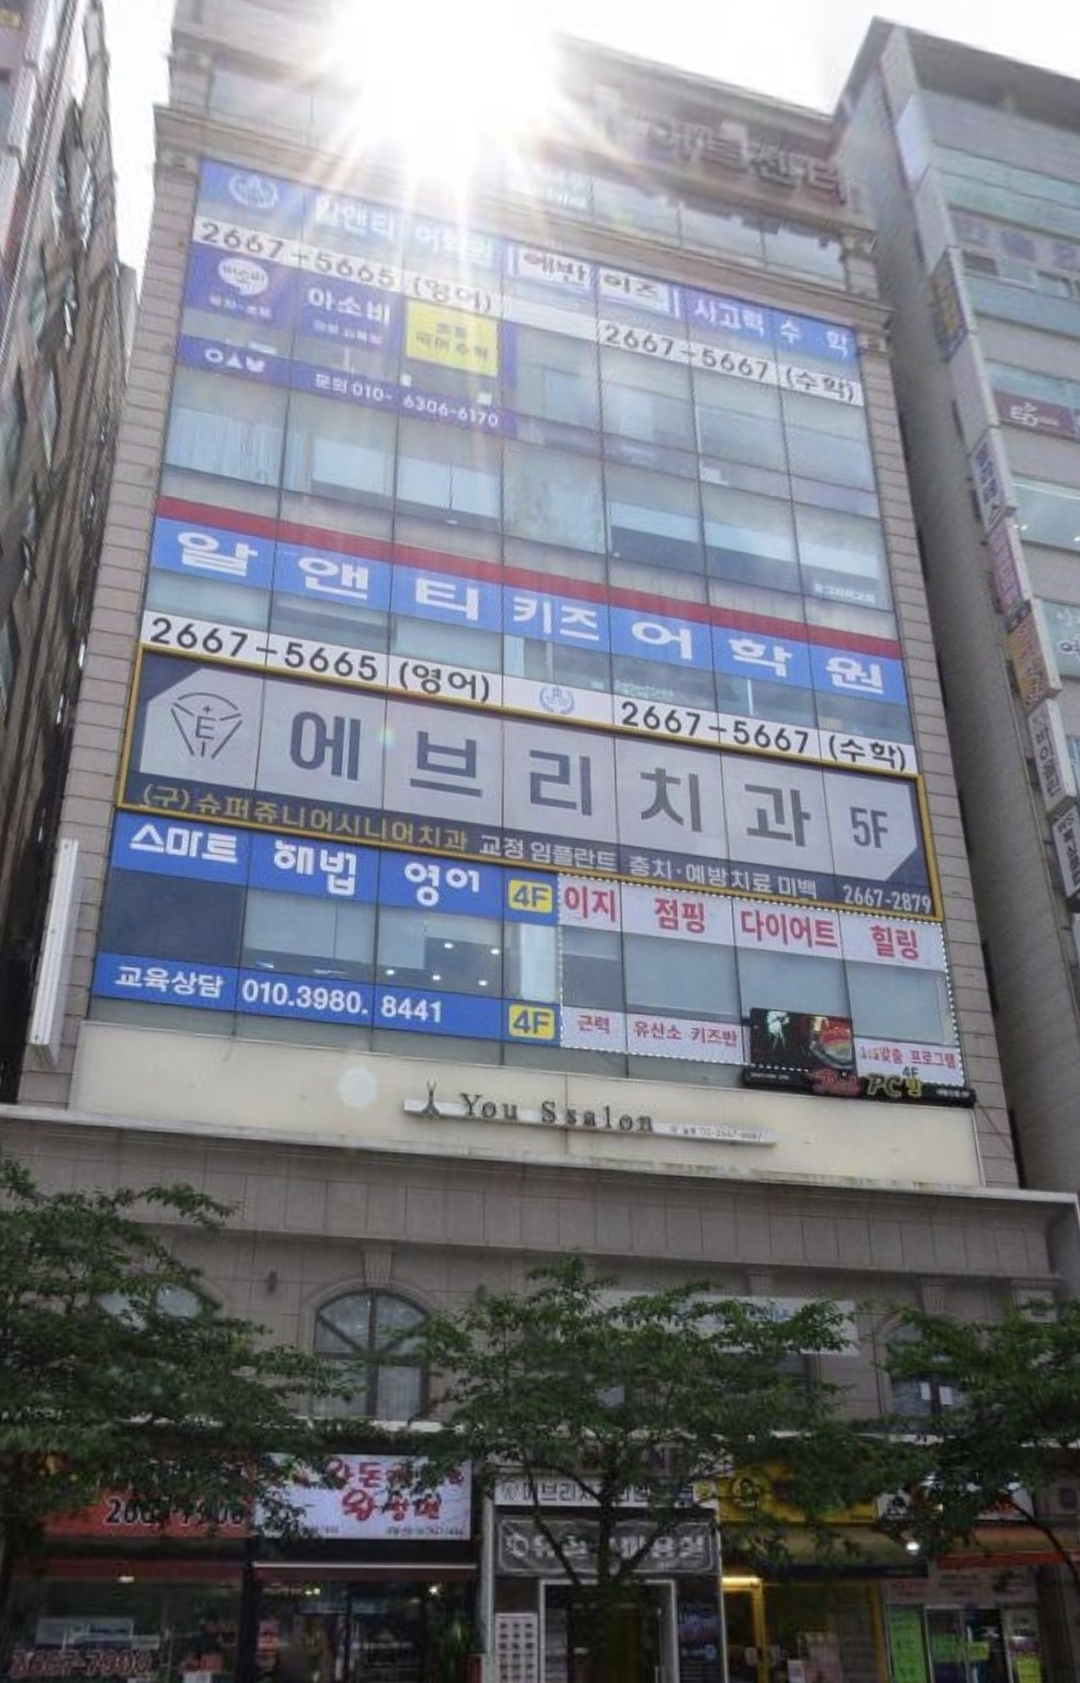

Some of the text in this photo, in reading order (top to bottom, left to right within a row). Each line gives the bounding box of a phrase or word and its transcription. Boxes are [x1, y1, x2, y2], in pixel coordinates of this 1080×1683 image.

[202, 222, 395, 288] 2667-5665
[308, 287, 390, 326] 아소비
[605, 324, 768, 382] 2667-5667
[150, 617, 379, 682] 2667-5665
[399, 660, 490, 703] (영어)
[621, 702, 907, 773] 2667-5667 (수학)
[850, 806, 889, 849] 5F
[129, 823, 552, 908] 스마트 해법 영어 4F
[479, 834, 524, 860] 교정
[531, 842, 618, 872] 임플란트
[778, 880, 817, 901] 미백
[842, 885, 933, 914] 2667-2879
[564, 885, 920, 960] 이지 점핑 다이어트 힐링
[115, 965, 224, 999] 교육상담
[512, 1009, 552, 1036] 4F
[576, 1013, 738, 1048] 근력 유산소 키즈반
[910, 1049, 957, 1070] 프로그램
[460, 1092, 518, 1122] You
[541, 1100, 654, 1133] Ssalon
